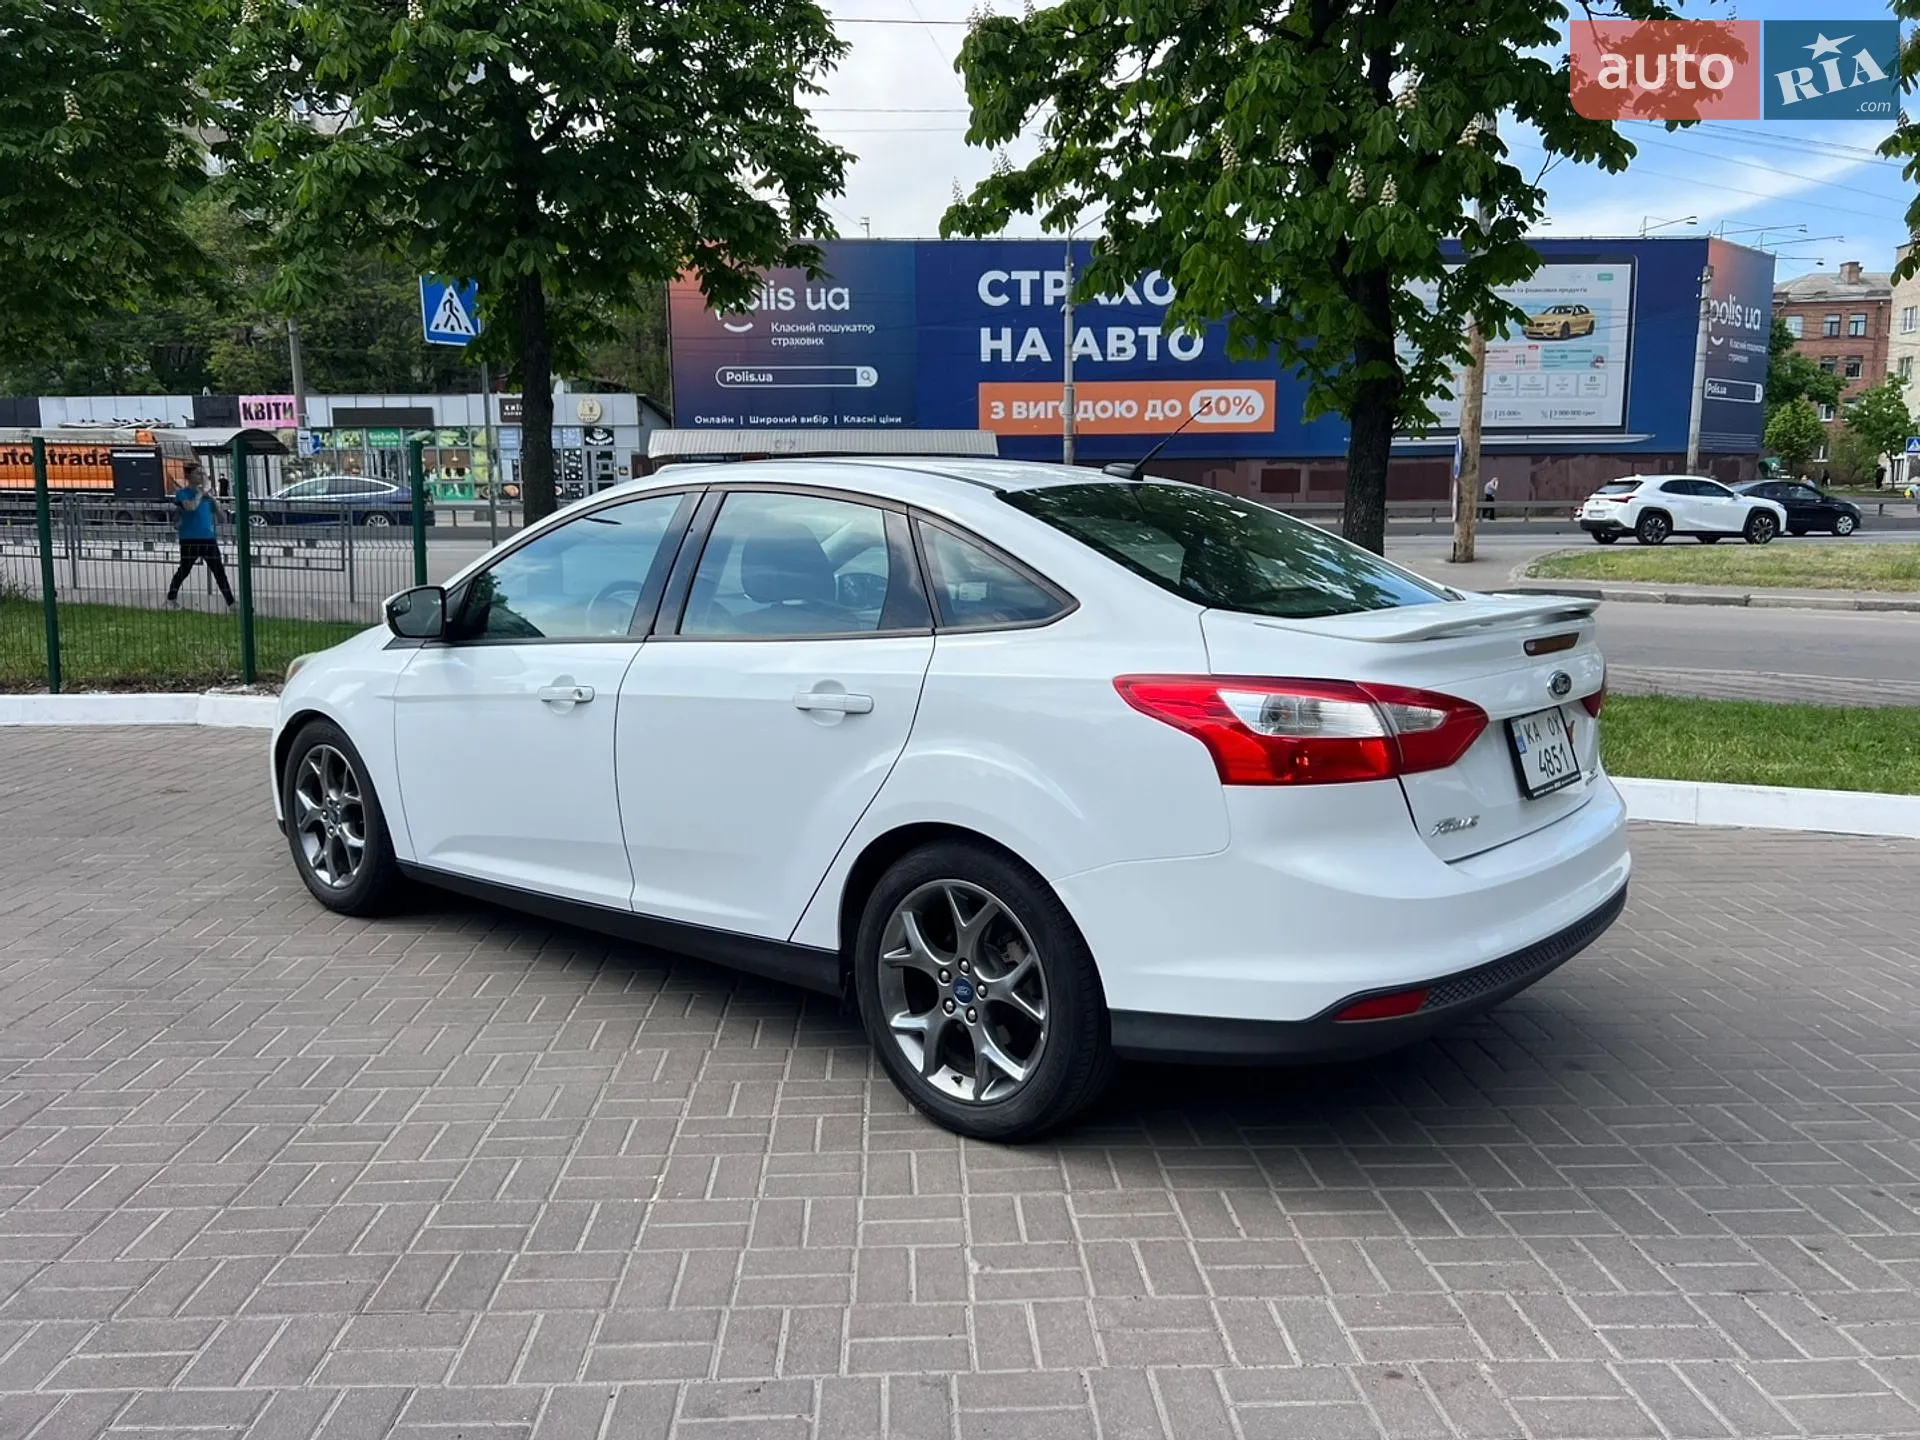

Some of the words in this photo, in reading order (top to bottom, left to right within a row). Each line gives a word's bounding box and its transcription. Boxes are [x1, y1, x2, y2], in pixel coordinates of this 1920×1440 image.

[715, 280, 795, 321] olis
[806, 287, 850, 311] ua
[1708, 294, 1743, 332] polis
[1745, 306, 1761, 331] ua
[771, 322, 816, 333] Класний
[818, 323, 875, 334] пошукатор
[771, 336, 824, 347] страхових
[980, 327, 1052, 362] НА
[1071, 326, 1204, 362] АВТО
[726, 371, 773, 382] Polis.ua
[242, 402, 294, 421] КВІТИ
[1144, 399, 1182, 421] ДО
[1199, 396, 1255, 416] 50%
[695, 415, 735, 424] Онлайн
[749, 414, 798, 424] Широкий
[800, 415, 829, 425] вибір
[843, 415, 877, 424] Класні
[879, 415, 902, 425] ціни
[0, 449, 111, 466] utotrada
[1524, 721, 1542, 744] KA
[1538, 742, 1570, 779] 4851
